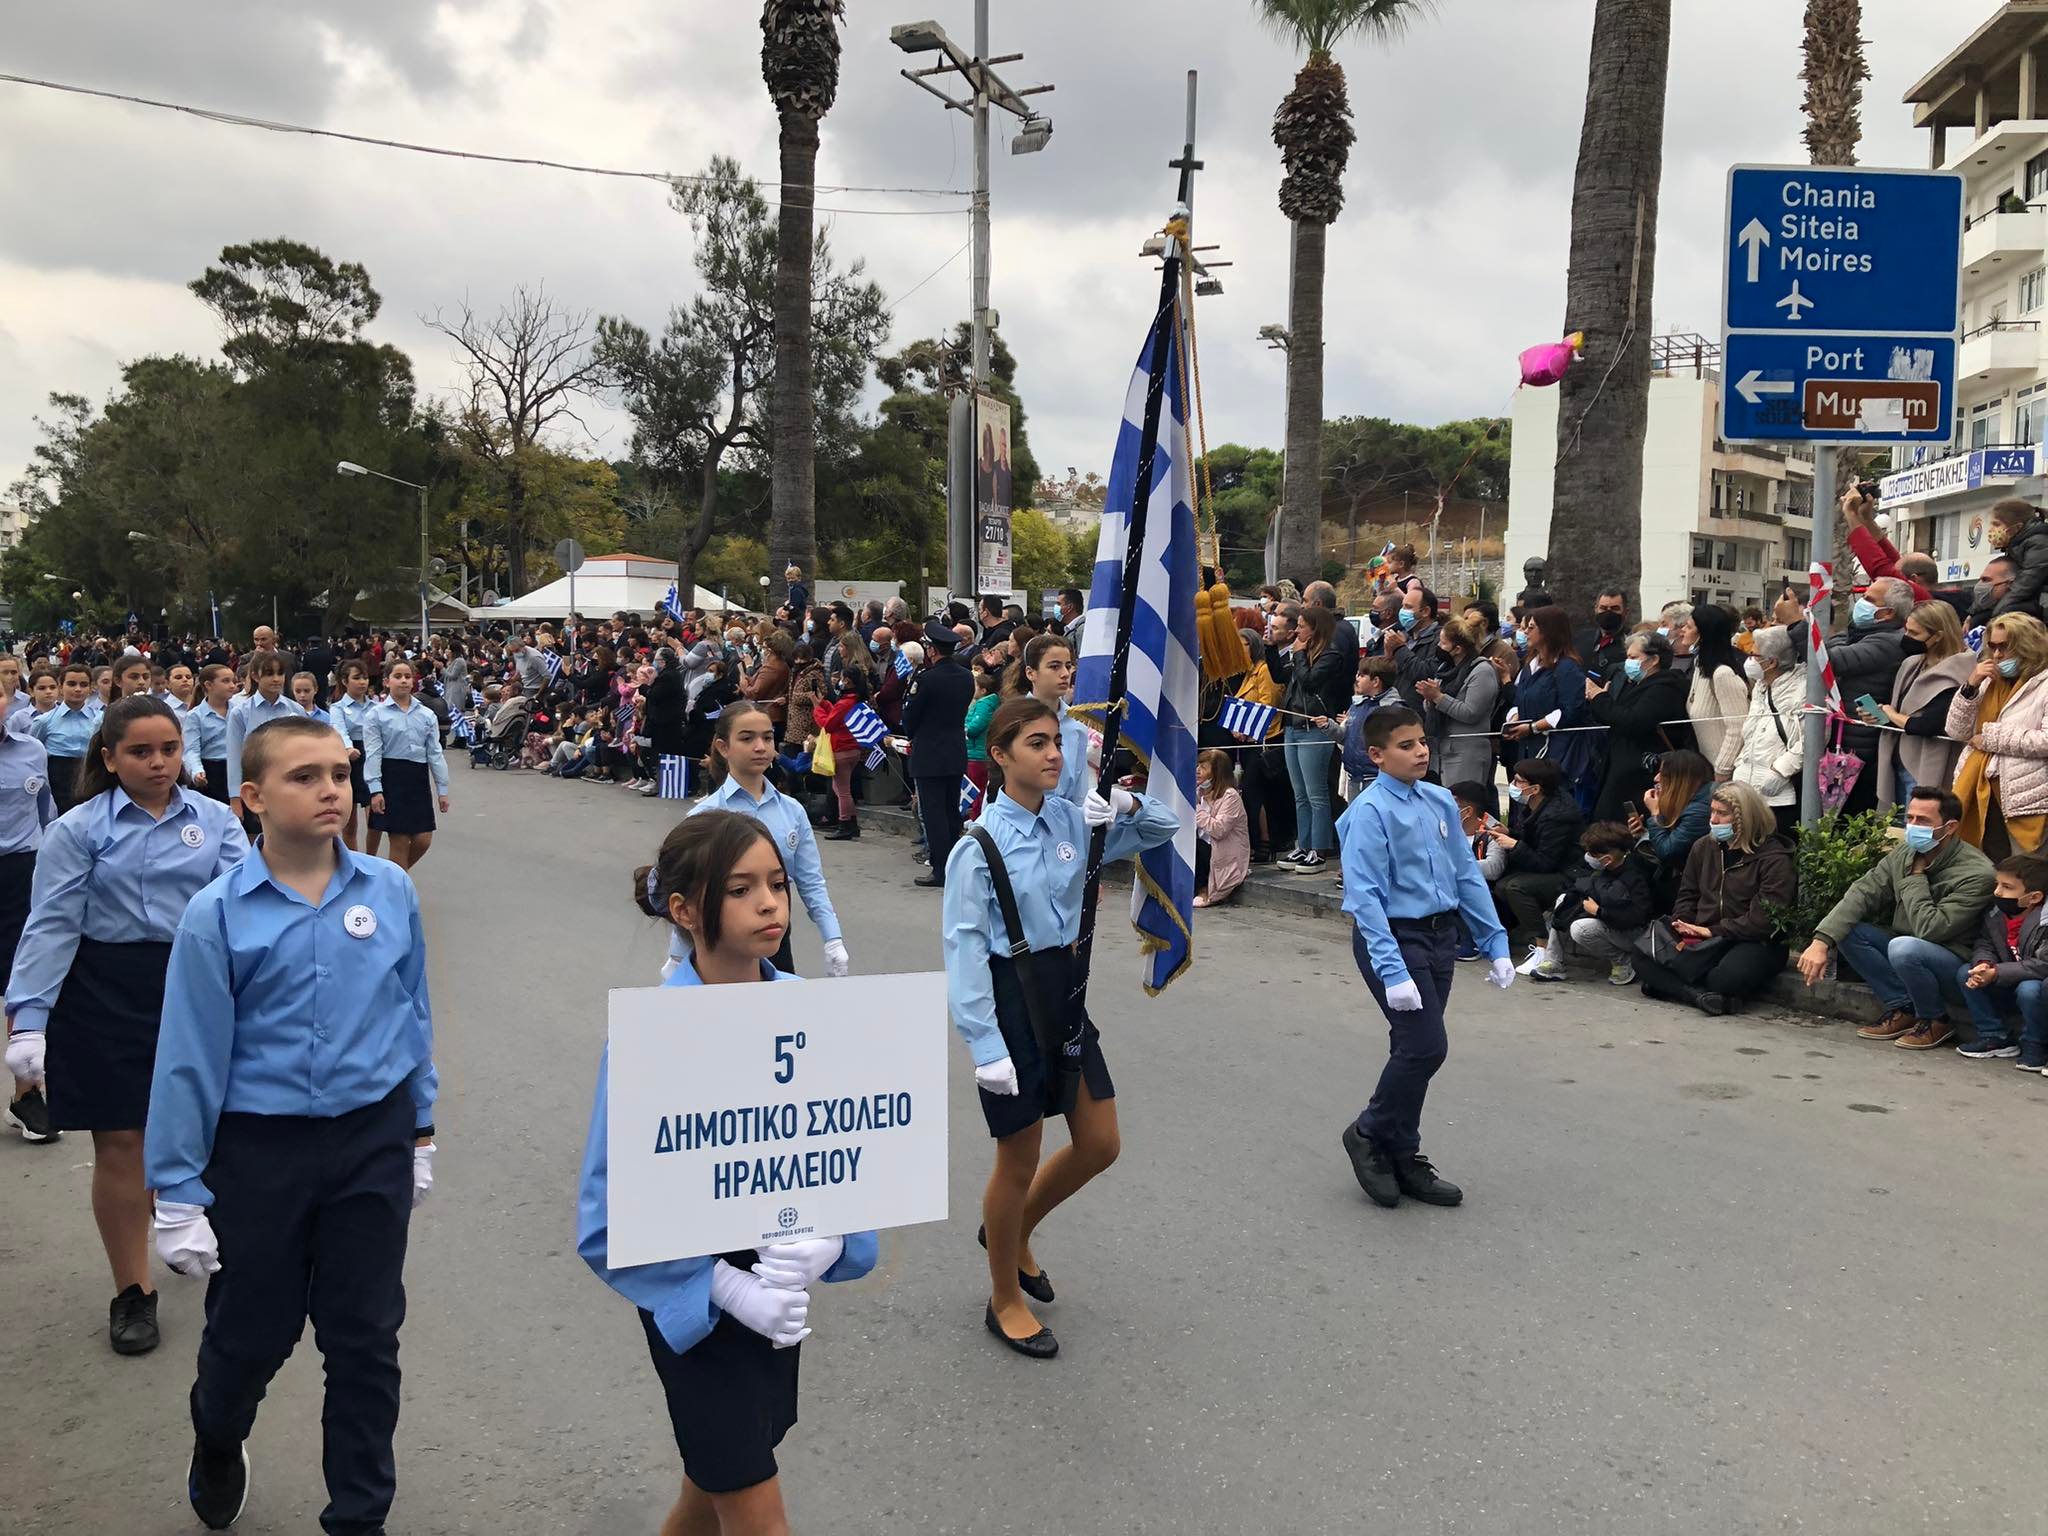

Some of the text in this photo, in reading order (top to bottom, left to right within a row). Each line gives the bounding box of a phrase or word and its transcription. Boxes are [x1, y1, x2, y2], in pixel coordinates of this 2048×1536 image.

[1782, 181, 1876, 209] Chania
[1781, 215, 1859, 241] Siteia
[1780, 246, 1873, 273] Moires
[1807, 346, 1864, 371] Port
[985, 526, 1004, 541] 27/10
[1947, 560, 1963, 580] play
[654, 1091, 912, 1154] ΔΗΜΟΤΙΚΟ ΣΧΟΛΕΙΟ
[713, 1146, 862, 1200] ΗΡΑΚΛΕΙΟΥ
